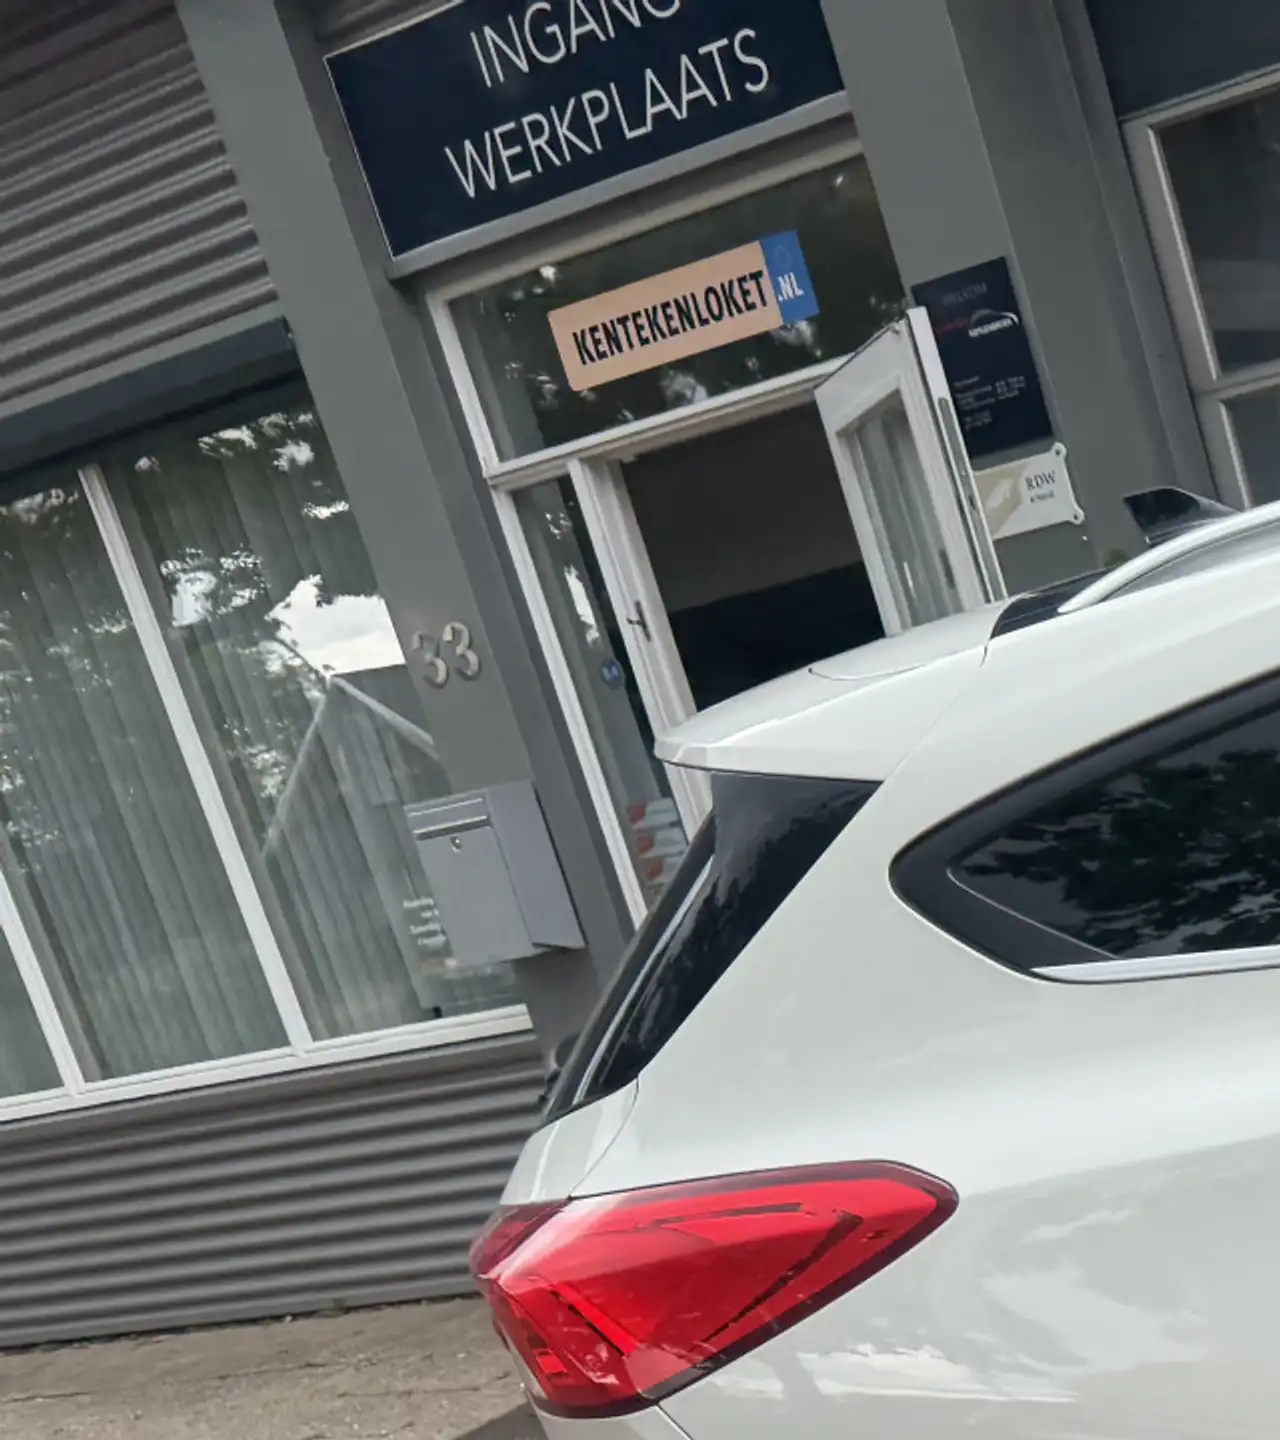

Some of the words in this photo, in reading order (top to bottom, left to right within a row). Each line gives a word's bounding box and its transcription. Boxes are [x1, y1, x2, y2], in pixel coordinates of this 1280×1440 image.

[444, 28, 770, 199] WERKPLAATS
[1025, 469, 1056, 491] RDW
[412, 621, 481, 688] 33
